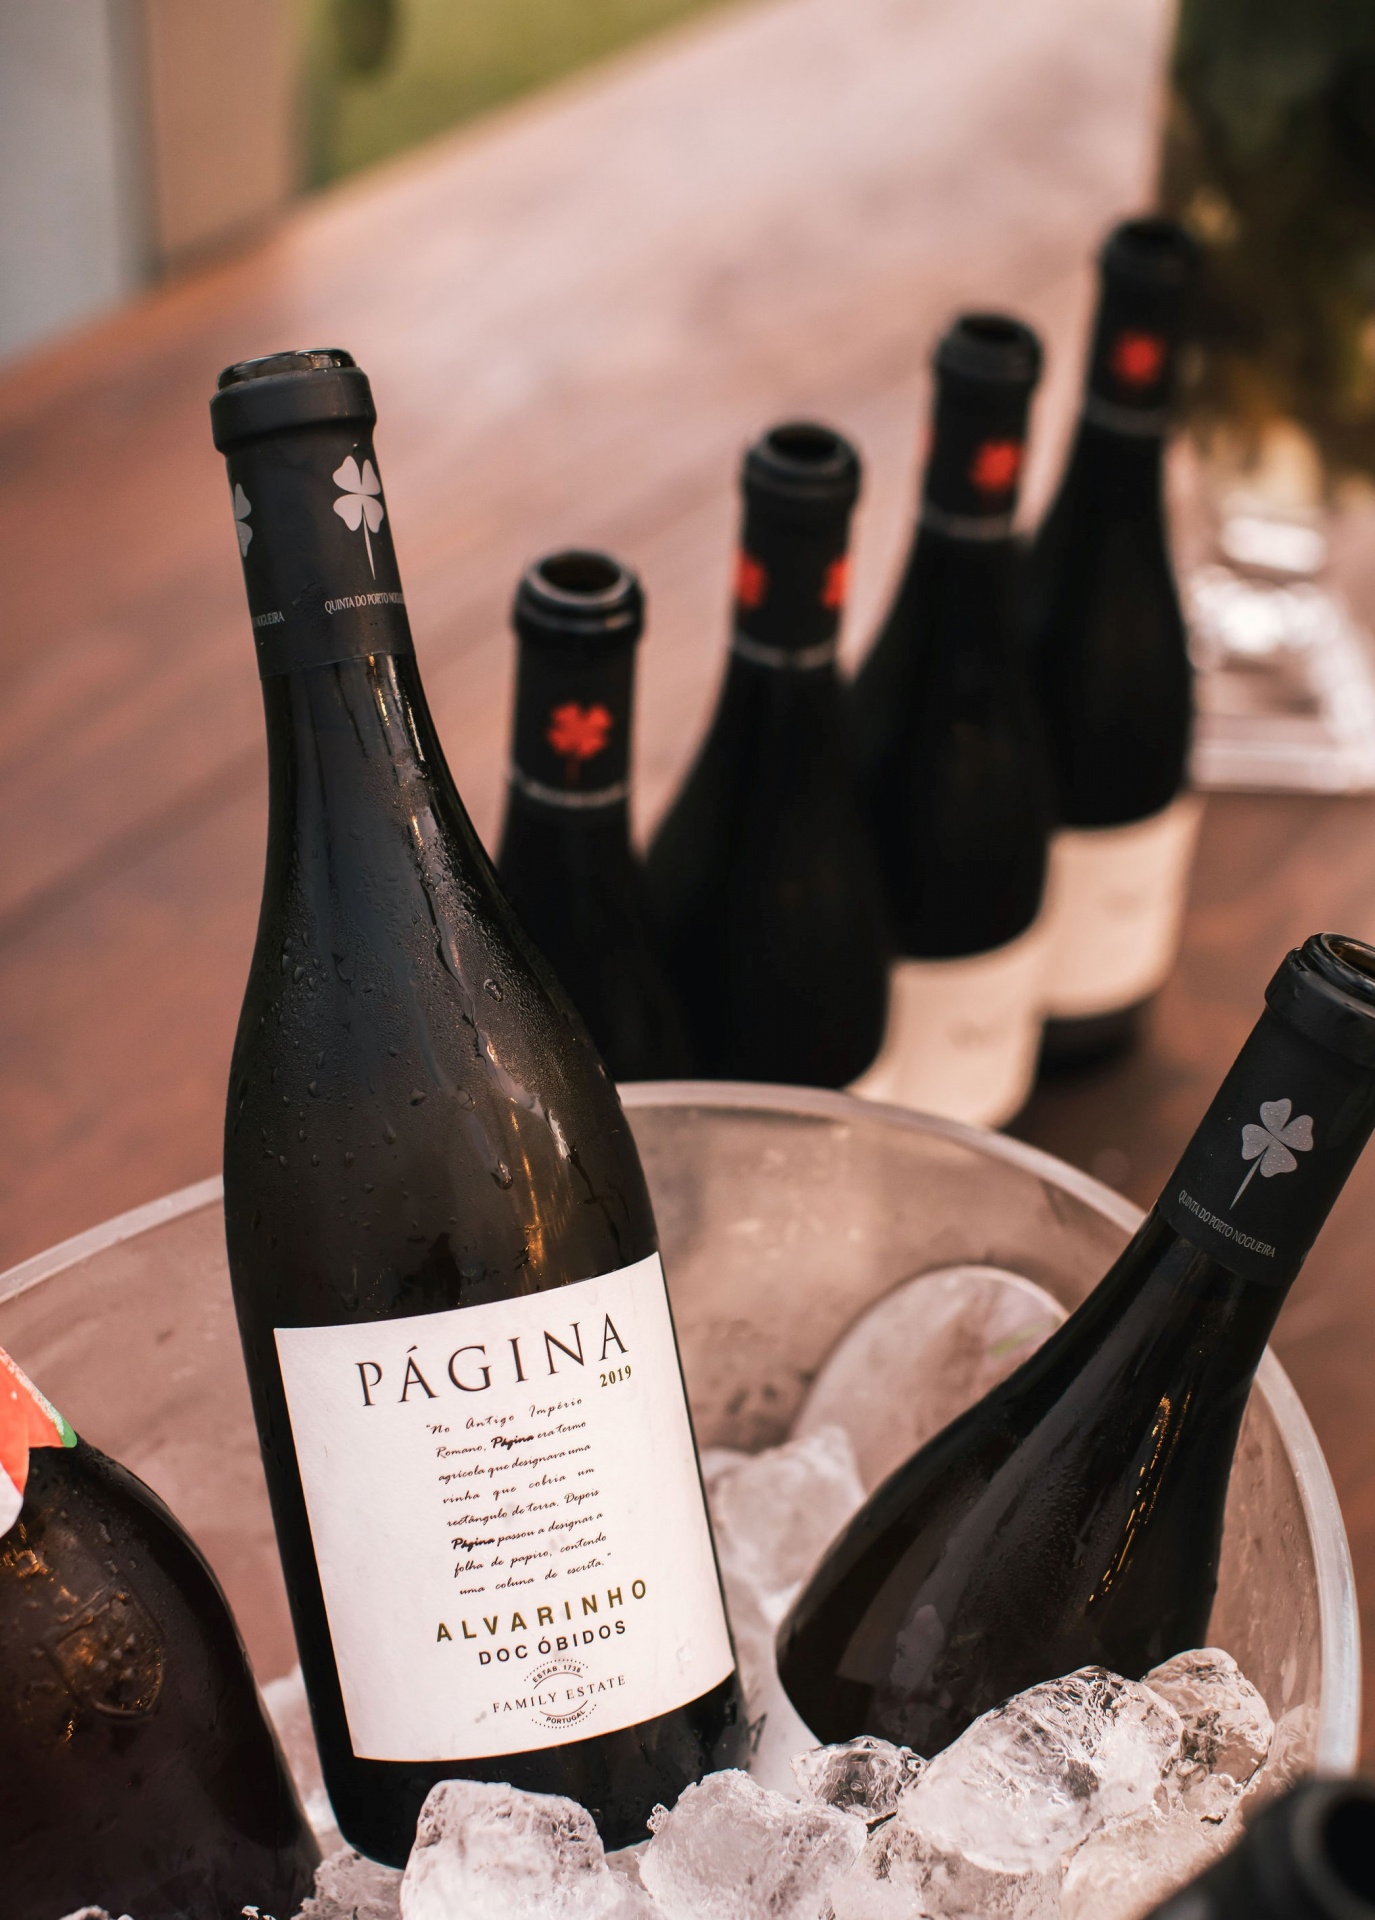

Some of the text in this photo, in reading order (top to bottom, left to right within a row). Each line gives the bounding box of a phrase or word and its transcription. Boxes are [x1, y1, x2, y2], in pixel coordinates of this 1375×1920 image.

[324, 597, 355, 614] QUINTA
[355, 595, 367, 607] DO
[367, 592, 389, 605] PORTO
[1178, 1189, 1276, 1258] QUINTA DO PORTO NOGUEIRA
[354, 1312, 629, 1407] PÁGINA
[599, 1365, 632, 1388] 2019
[465, 1414, 515, 1430] Antigo
[529, 1398, 582, 1417] Império
[555, 1421, 586, 1434] termo
[487, 1463, 510, 1478] que
[511, 1451, 567, 1469] designava
[568, 1443, 591, 1455] uma
[442, 1467, 595, 1504] vinha que cobria um
[512, 1504, 525, 1516] de
[563, 1488, 600, 1505] Depois
[497, 1530, 535, 1547] passou
[548, 1515, 594, 1532] designar
[454, 1559, 484, 1578] folha
[490, 1556, 504, 1568] de
[560, 1532, 607, 1553] contendo
[459, 1586, 485, 1595] uma
[495, 1577, 534, 1590] coluna
[544, 1569, 558, 1581] de
[436, 1579, 647, 1643] ALVARINHO
[478, 1619, 627, 1666] DOC ÓBIDOS
[492, 1674, 627, 1714] FAMILY ESTATE
[545, 1710, 586, 1725] PORTUGAL
